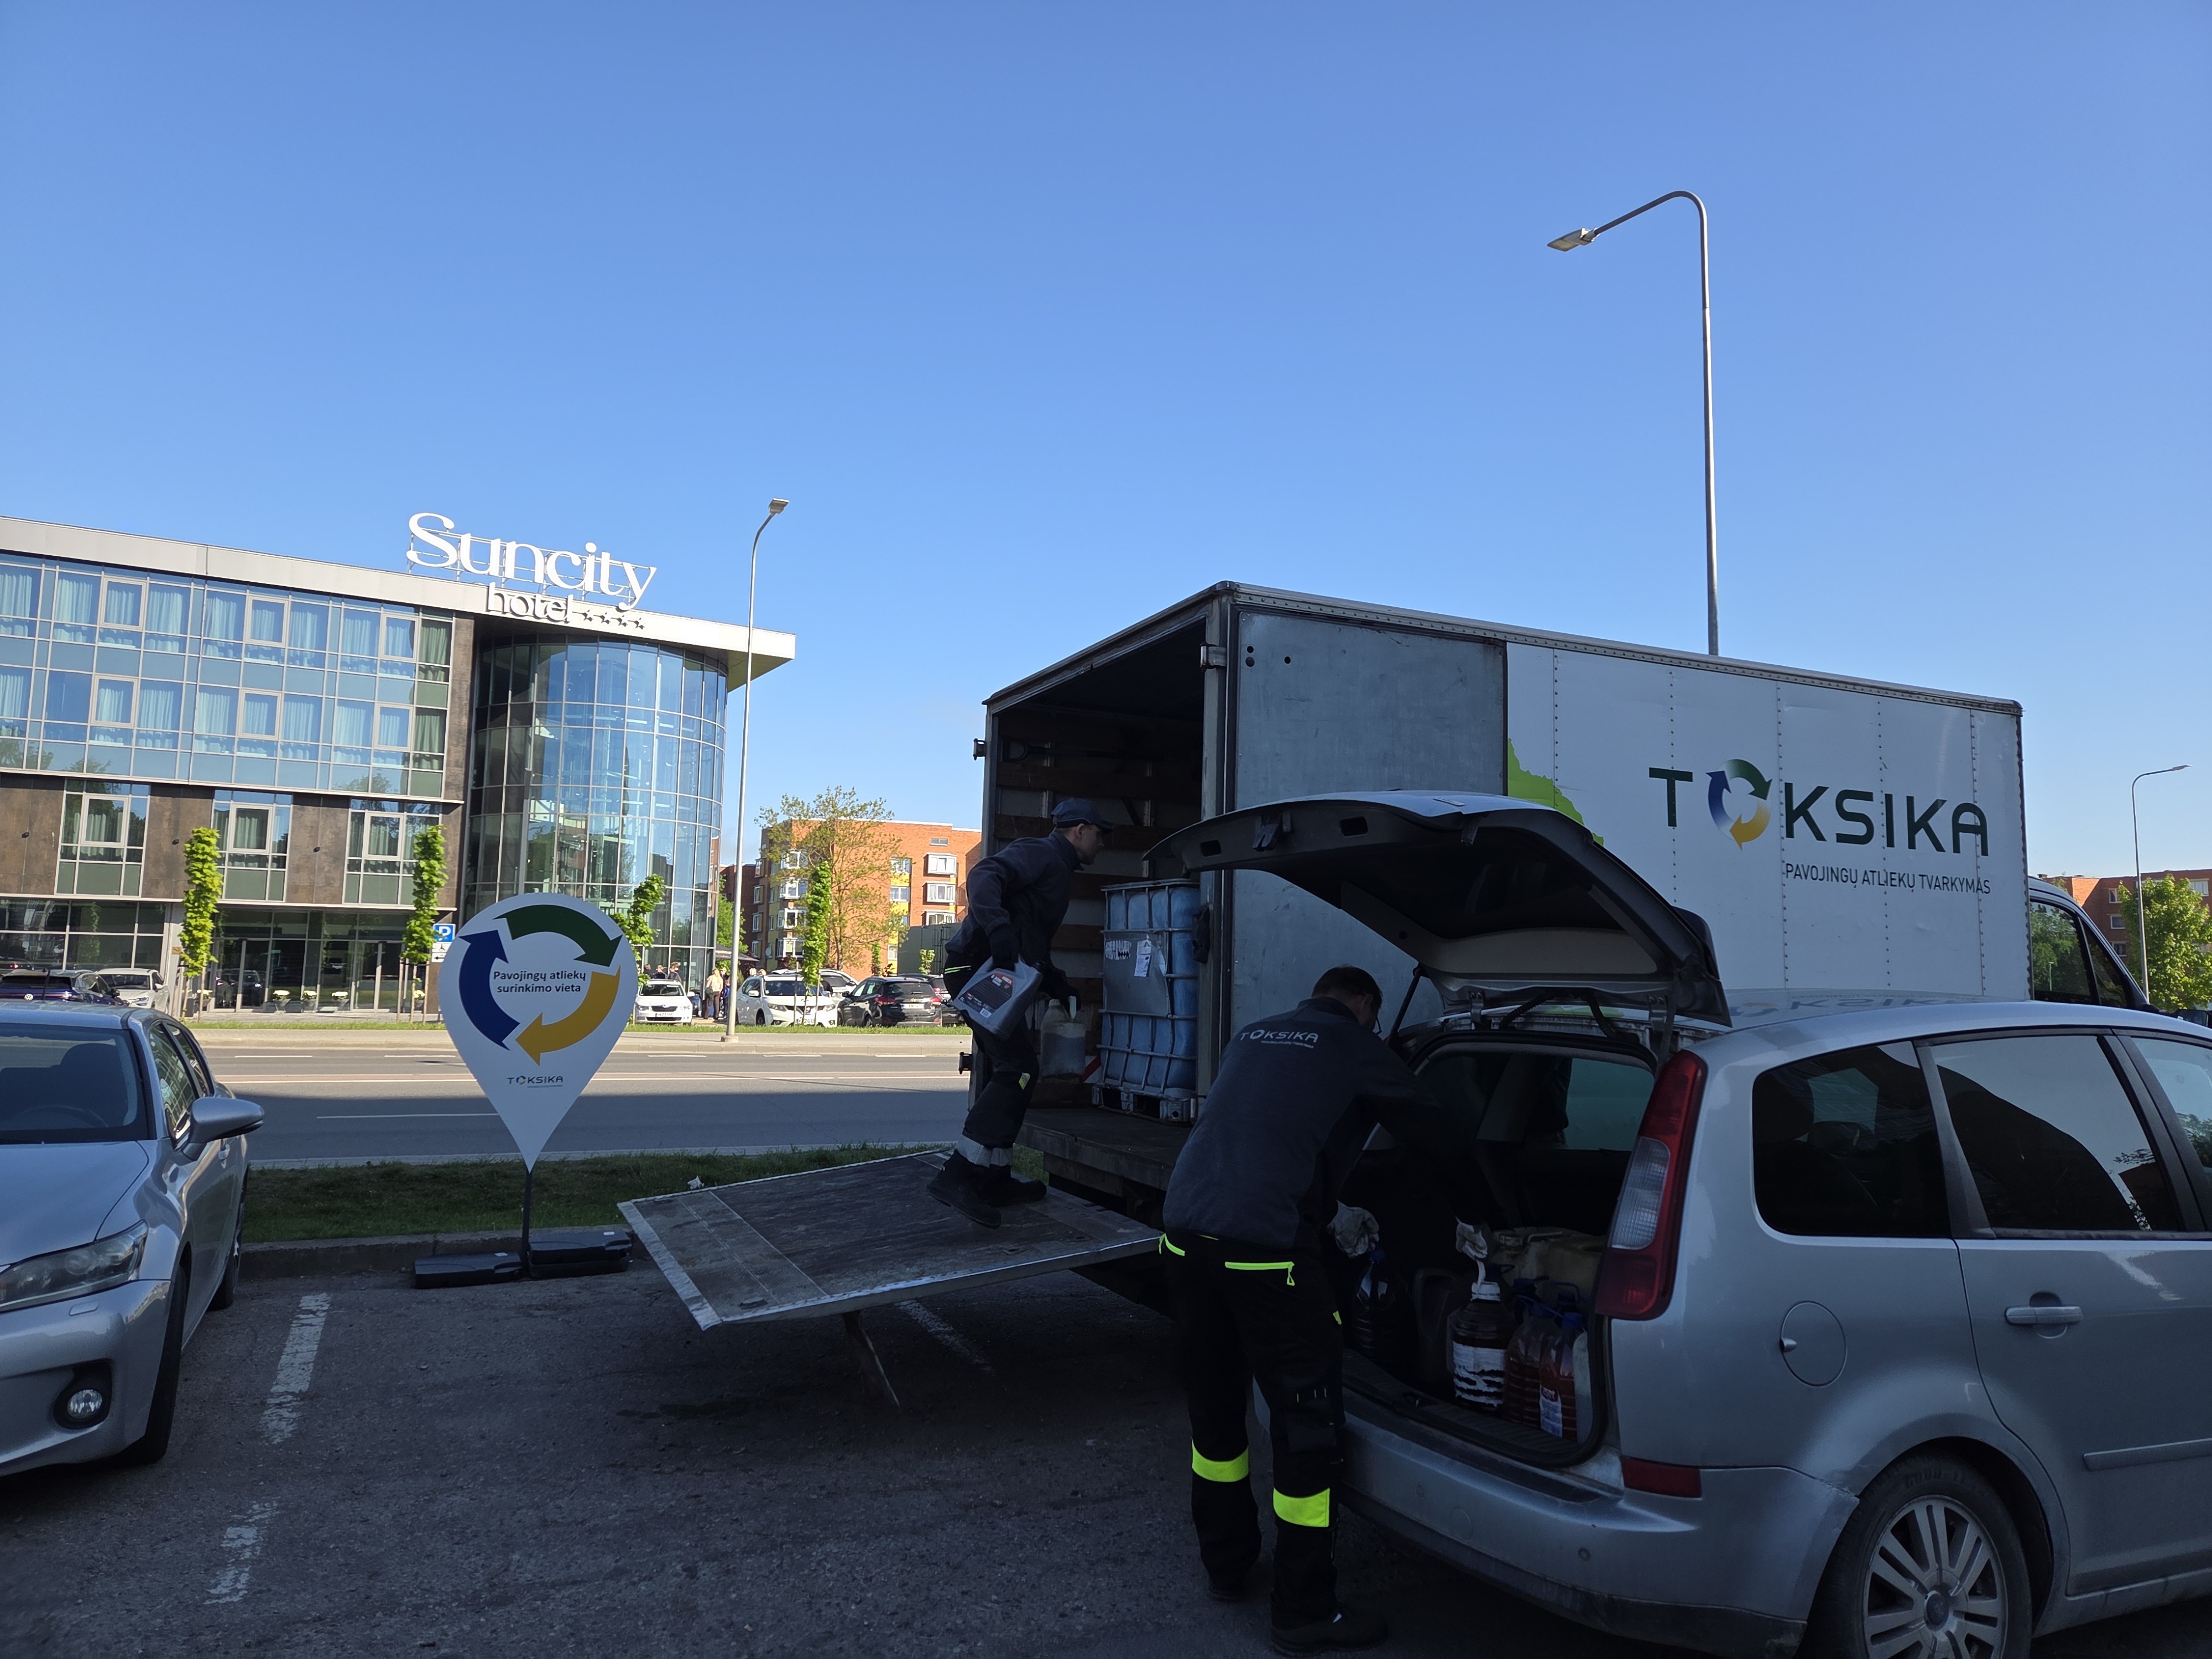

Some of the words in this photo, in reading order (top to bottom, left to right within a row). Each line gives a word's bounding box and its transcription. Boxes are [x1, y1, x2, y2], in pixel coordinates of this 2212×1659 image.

[406, 513, 656, 611] Suncity
[487, 581, 574, 623] hotel
[1785, 863, 1858, 888] PAVOJINGŲ
[1862, 869, 1916, 893] ATLIEKŲ
[1919, 874, 1991, 895] TVARKYMAS
[439, 926, 451, 941] P
[494, 971, 546, 982] Pavojingų
[550, 971, 586, 982] atliekų
[497, 983, 552, 993] surinkimo
[555, 983, 581, 993] vieta
[1239, 1029, 1319, 1043] TOKSIKA
